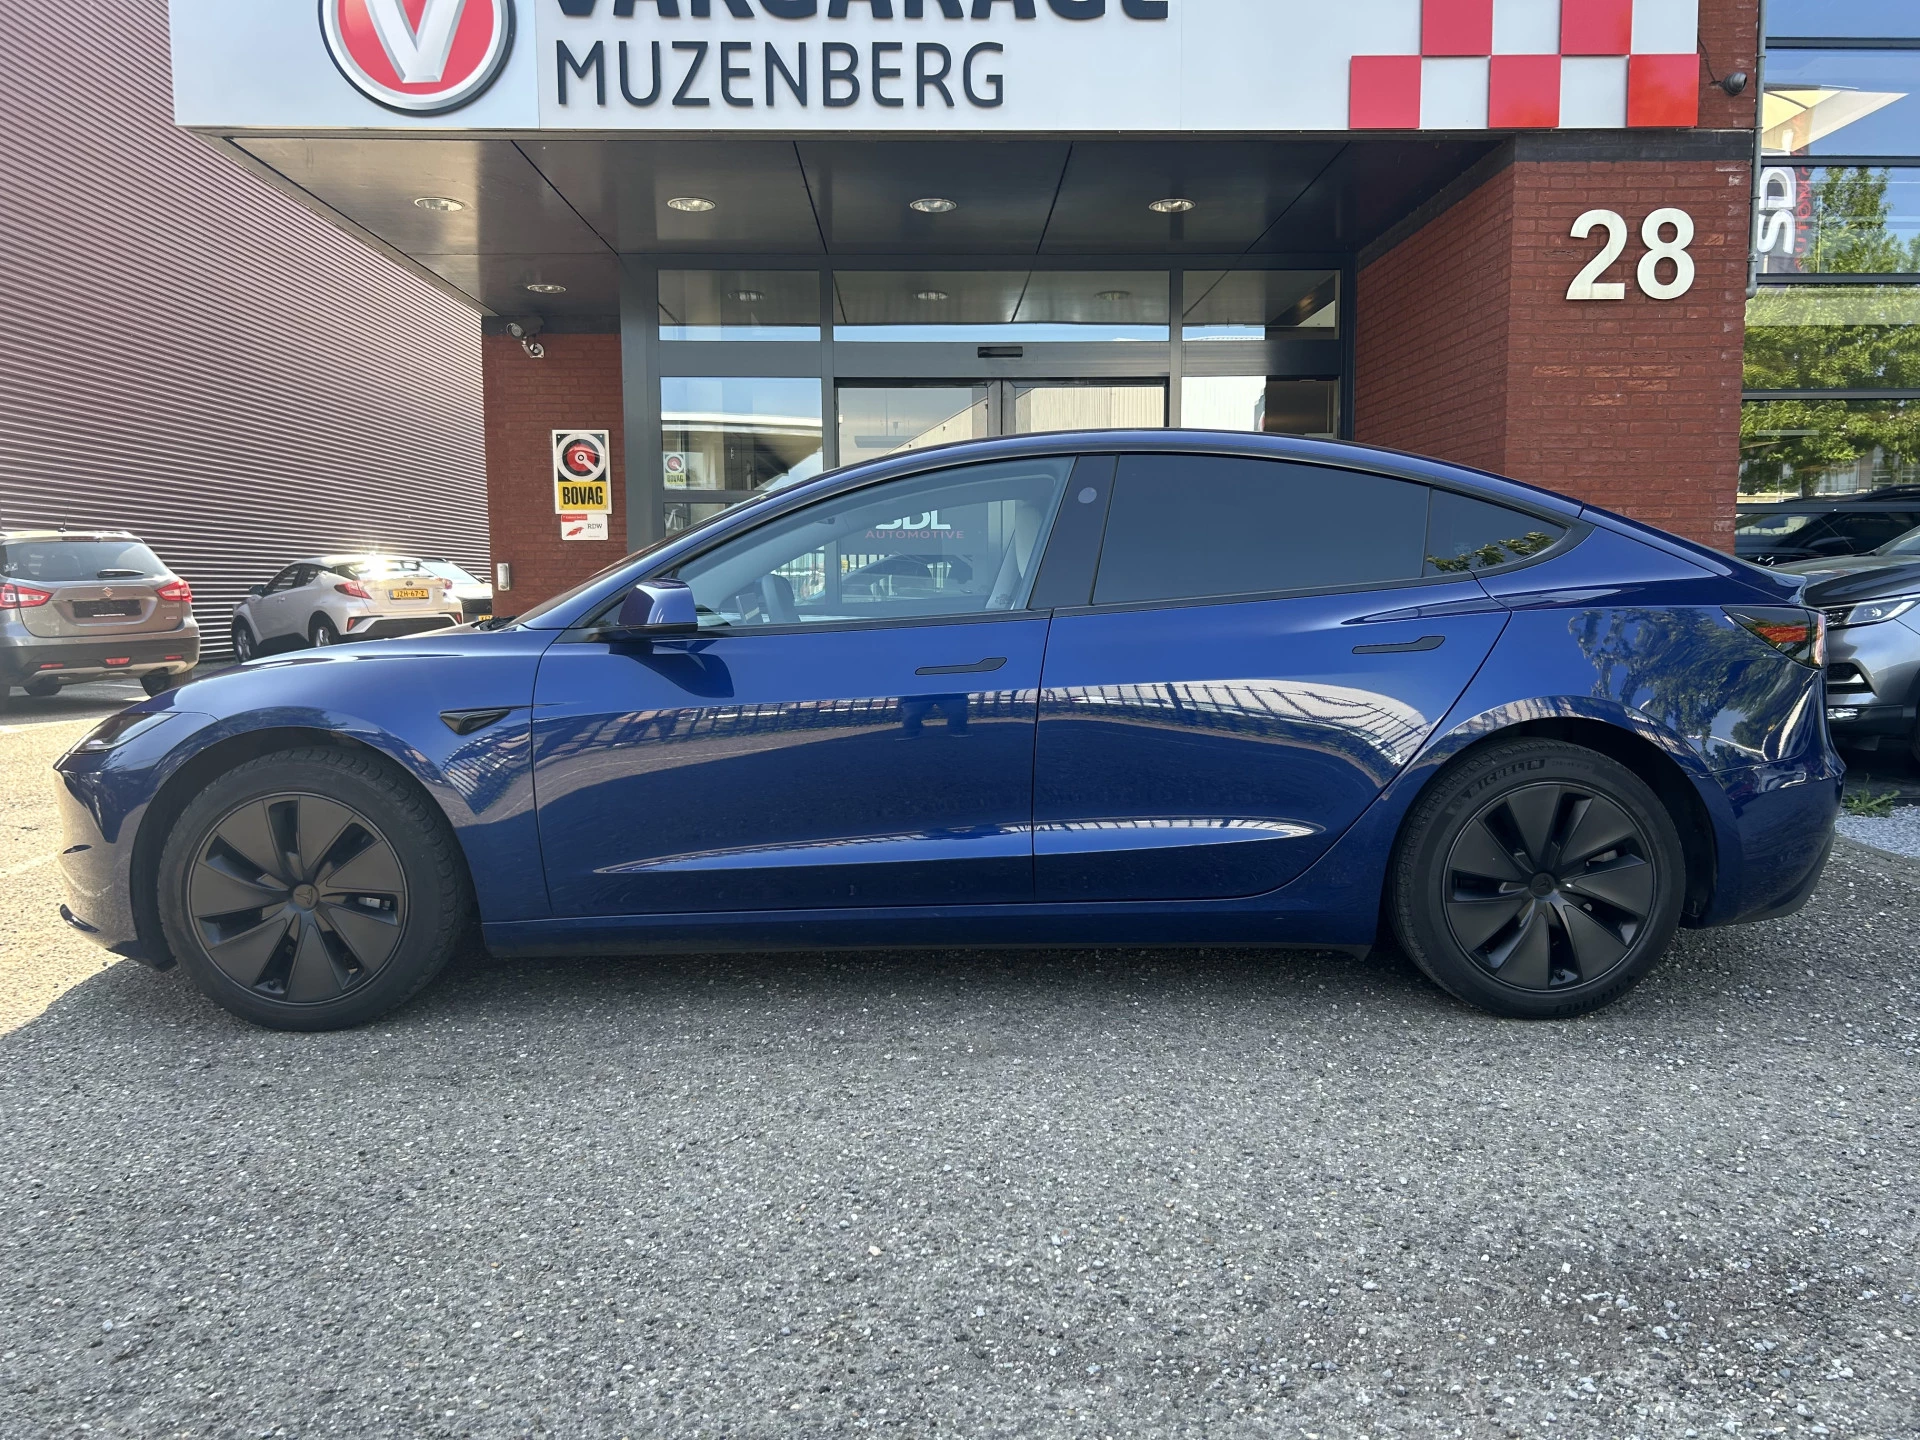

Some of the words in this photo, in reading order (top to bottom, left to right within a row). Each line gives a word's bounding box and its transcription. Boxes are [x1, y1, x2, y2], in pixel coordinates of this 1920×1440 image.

[556, 39, 1004, 108] MUZENBERG
[1566, 207, 1695, 300] 28
[667, 474, 684, 483] BOVAG
[562, 486, 603, 505] BOVAG
[865, 530, 965, 539] AUTOMOTIVE
